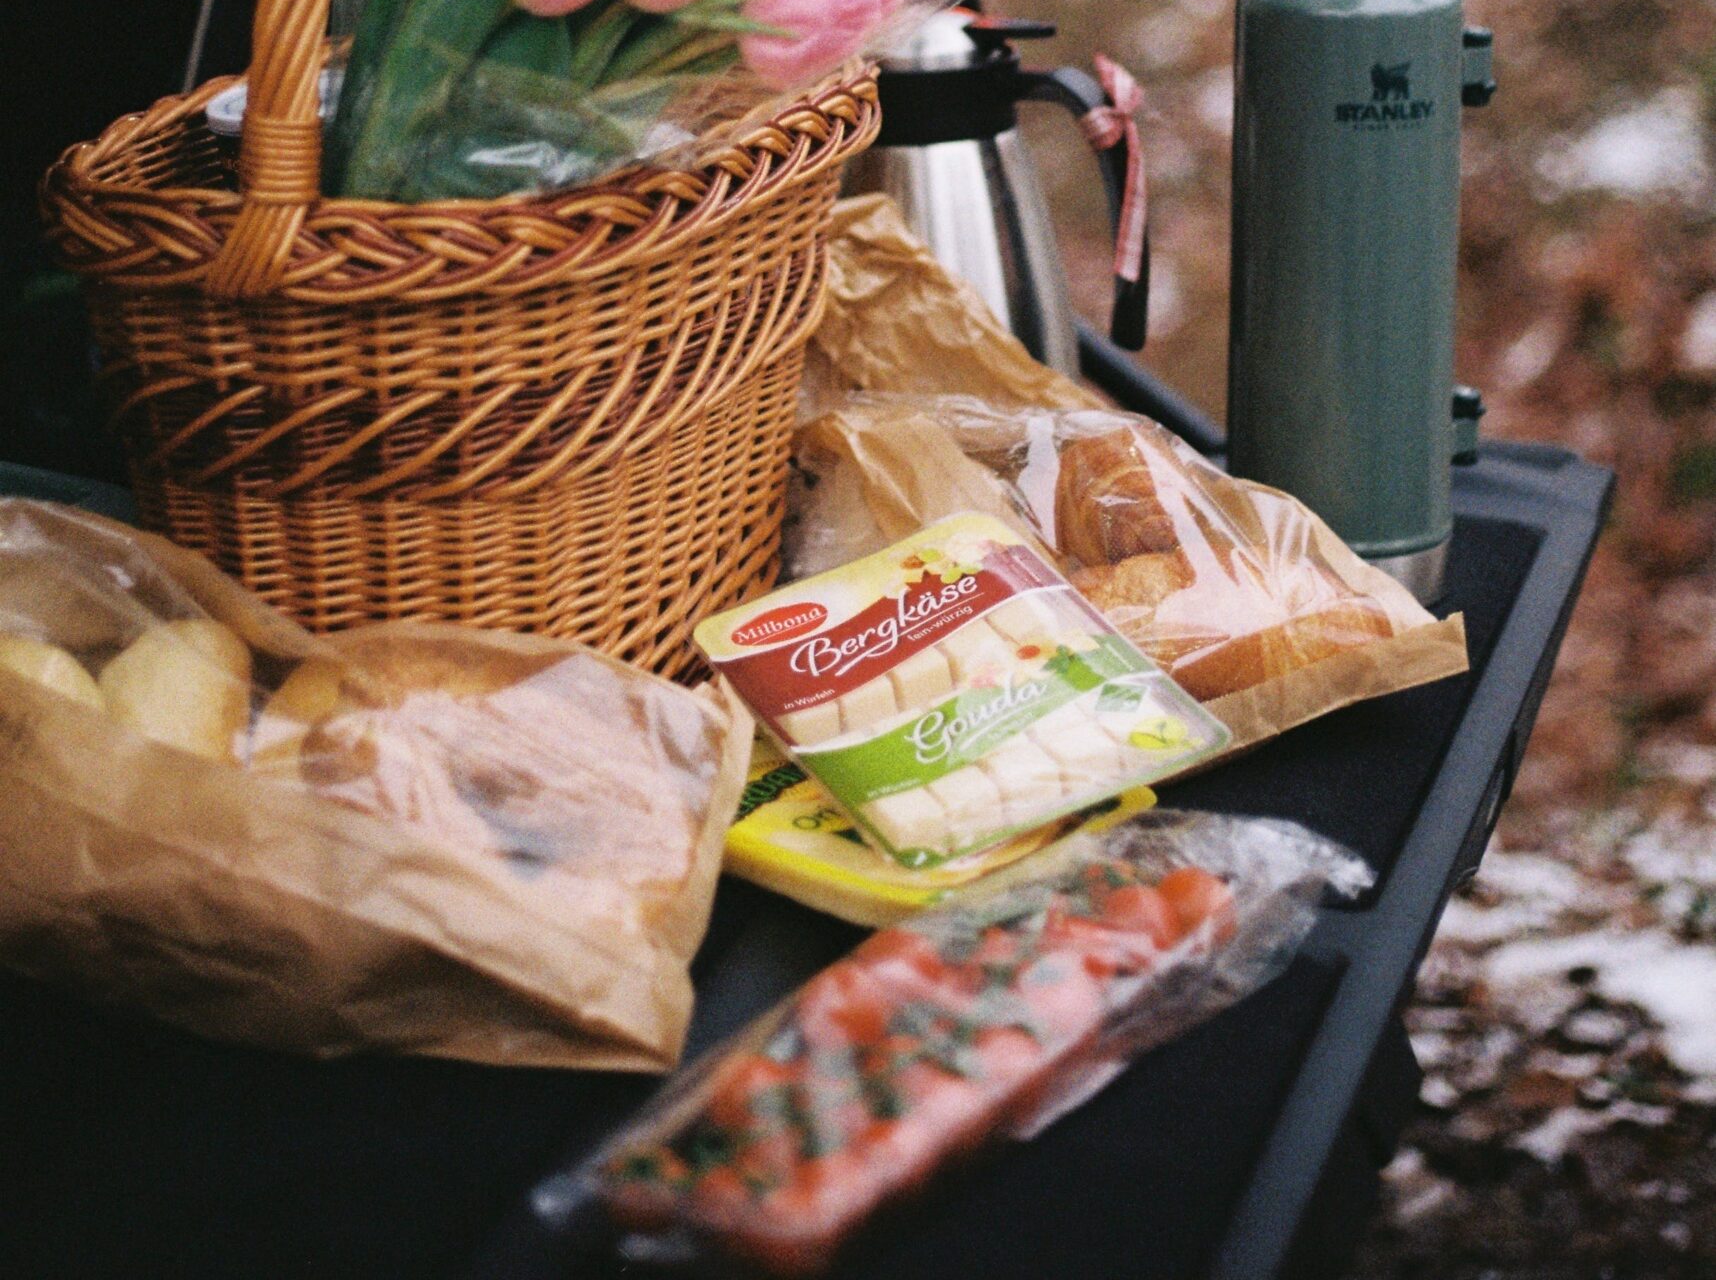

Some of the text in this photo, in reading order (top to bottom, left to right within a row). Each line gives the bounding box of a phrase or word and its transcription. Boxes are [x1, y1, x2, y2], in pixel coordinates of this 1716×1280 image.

[1335, 101, 1433, 121] STANLEY
[736, 604, 823, 644] Milbona
[789, 574, 978, 677] Bergkäse
[906, 605, 974, 641] fein-würzig
[903, 671, 1048, 764] Gouda
